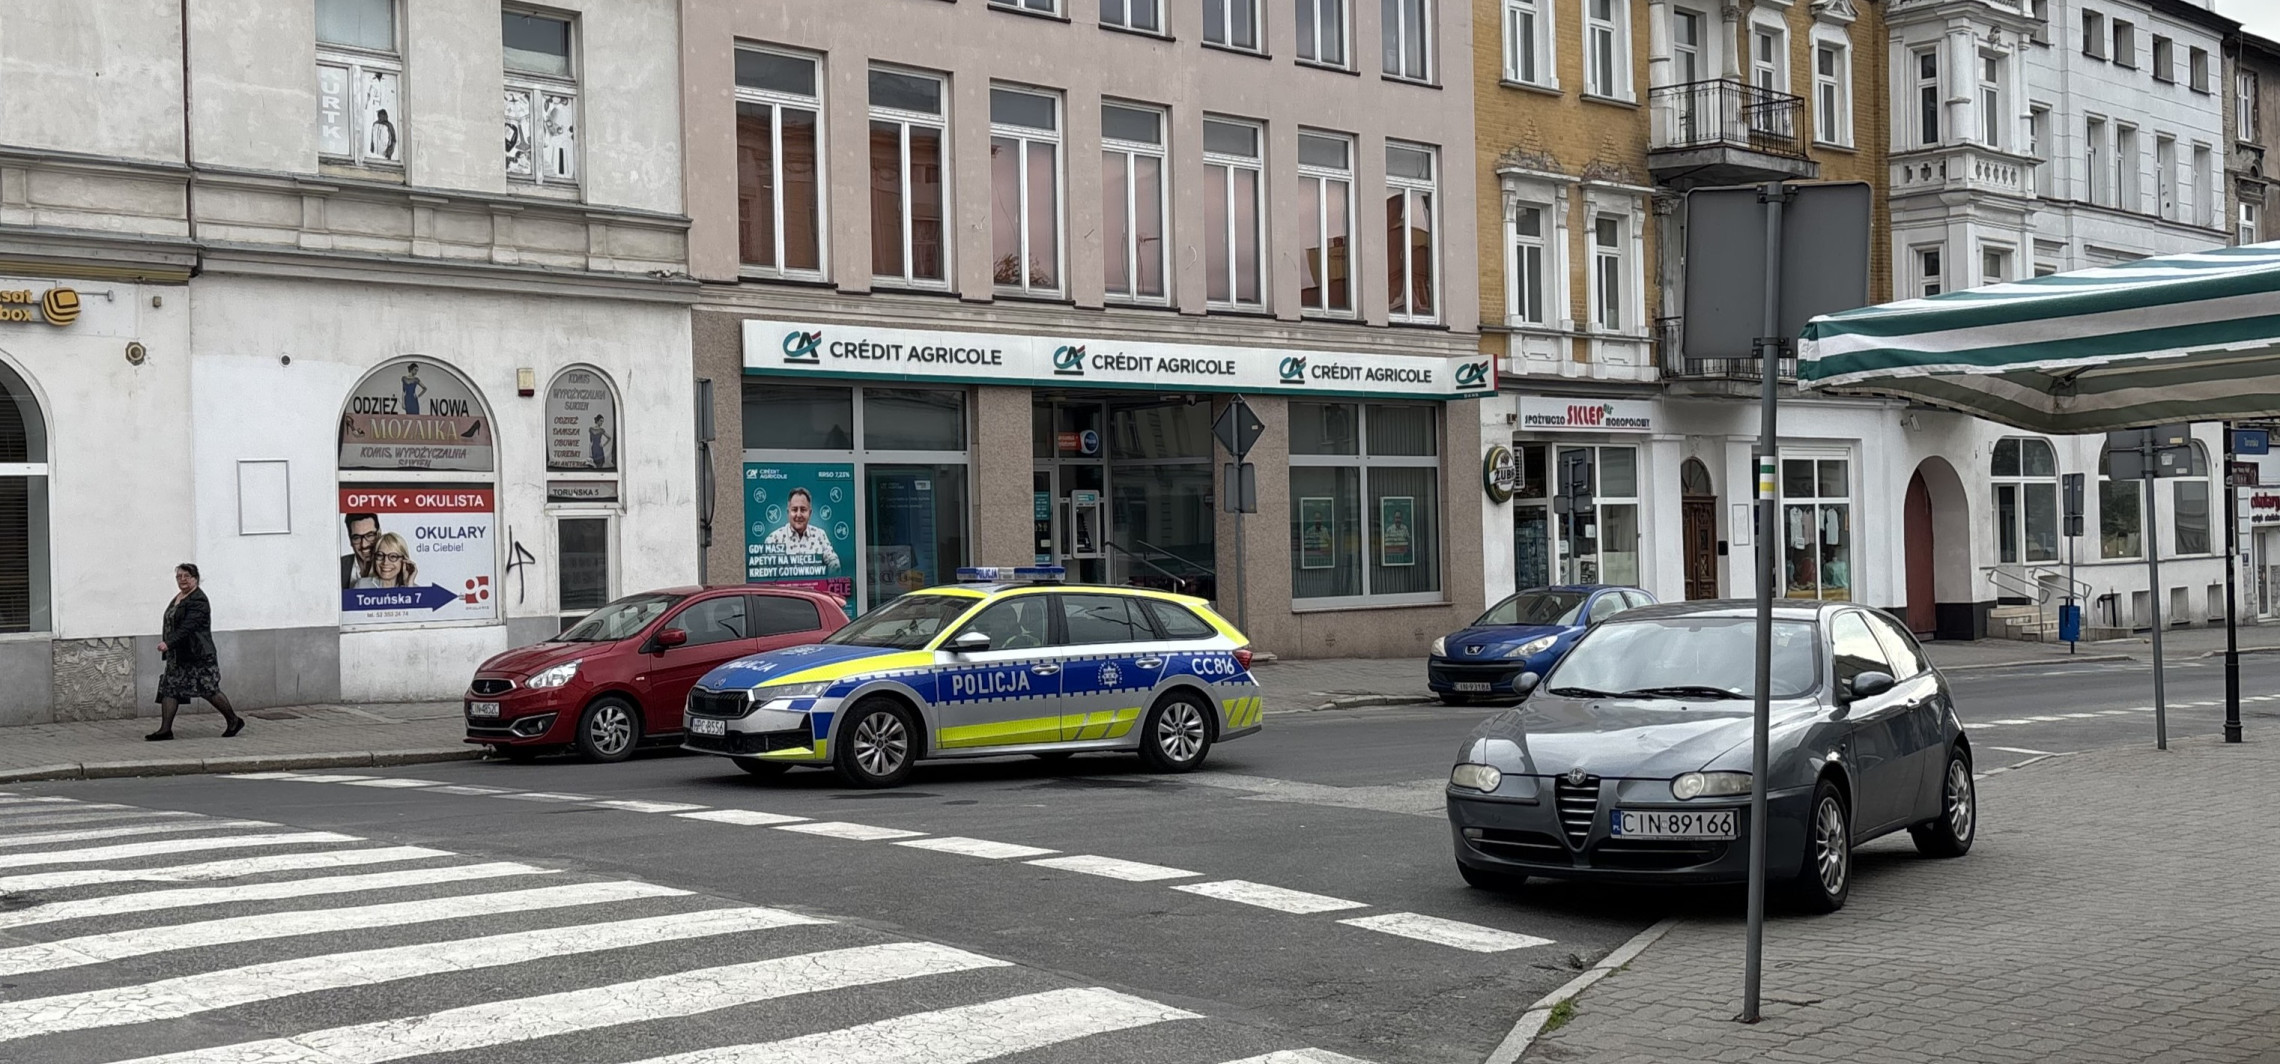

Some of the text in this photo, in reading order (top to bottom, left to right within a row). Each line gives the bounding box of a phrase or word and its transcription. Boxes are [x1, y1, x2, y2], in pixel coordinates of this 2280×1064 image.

[0, 289, 33, 303] sat
[829, 339, 1003, 365] CRÉDIT AGRICOLE
[1092, 352, 1236, 375] CRÉDIT AGRICOLE
[1311, 363, 1432, 383] CRÉDIT AGRICOLE
[353, 394, 470, 417] ODZIEŻ NOWA
[1567, 404, 1604, 426] SKLEP
[369, 417, 459, 441] MOZAIKA
[394, 446, 467, 459] WYPOŻYCZALNIA
[347, 494, 485, 507] OPTYK OKULISTA
[415, 526, 486, 539] OKULARY
[416, 542, 464, 553] dla Ciebie!
[749, 544, 786, 555] GDY MASZ
[749, 556, 777, 566] APETYT
[778, 555, 789, 565] NA
[749, 566, 827, 578] KREDYT GOTÓWKOWY
[976, 568, 998, 579] POLICJA
[356, 592, 422, 606] Toruńska 7
[952, 670, 1031, 696] POLICJA
[1622, 813, 1732, 834] CIN 89166
